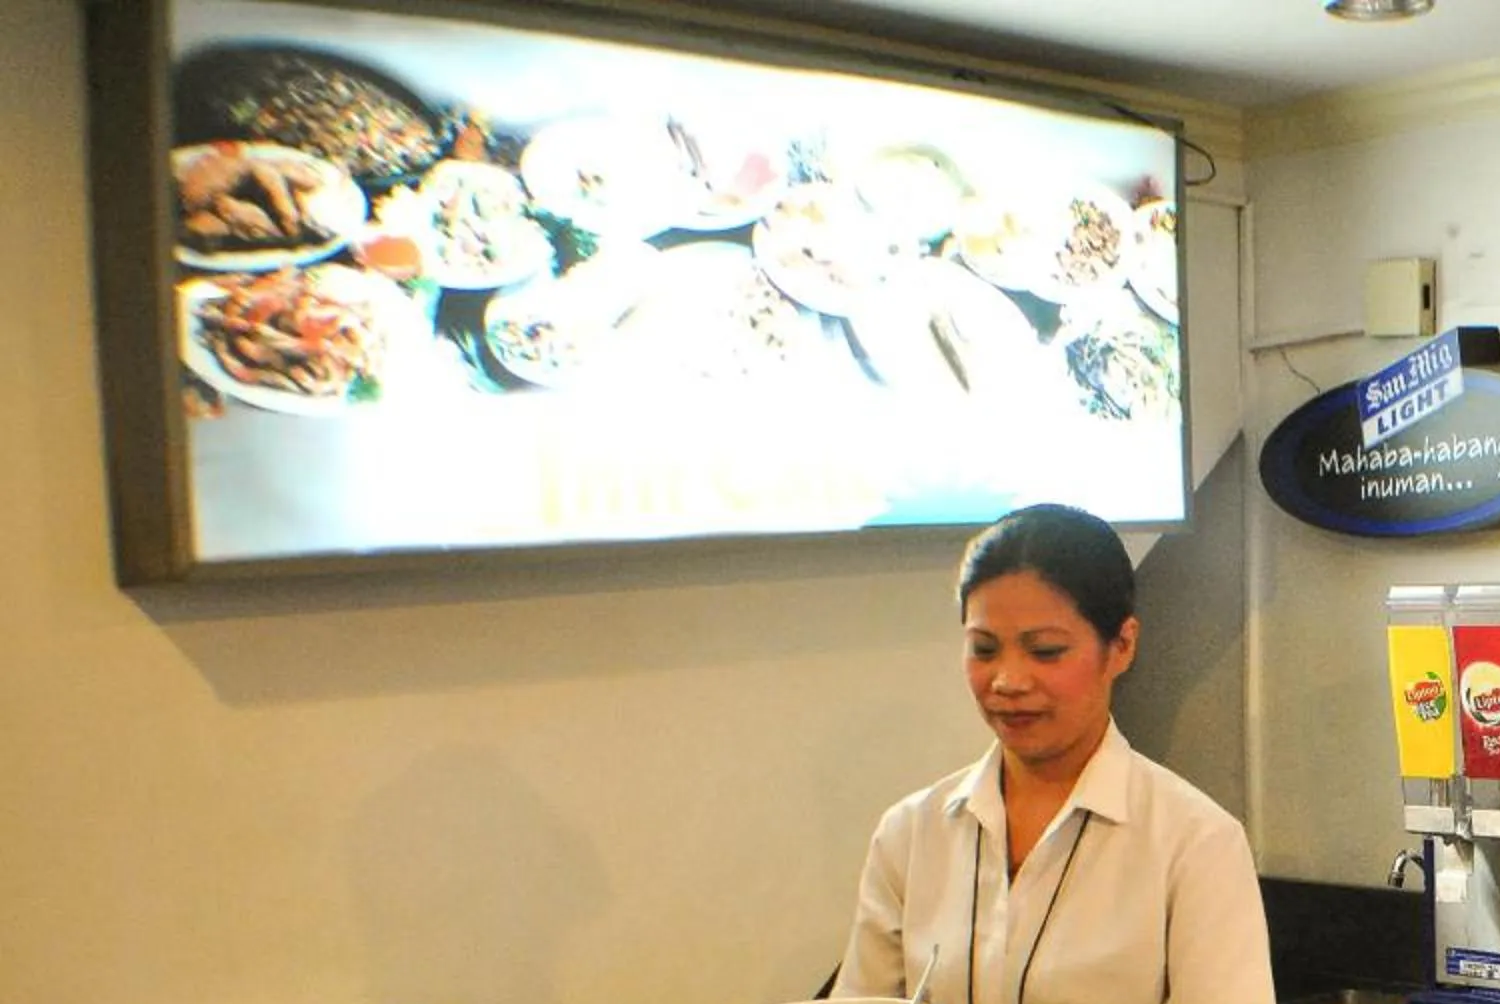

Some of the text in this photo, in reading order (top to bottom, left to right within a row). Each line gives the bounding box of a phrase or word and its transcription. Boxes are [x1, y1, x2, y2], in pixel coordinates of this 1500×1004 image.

[1366, 342, 1453, 411] San Mig
[1377, 380, 1452, 434] LIGHT
